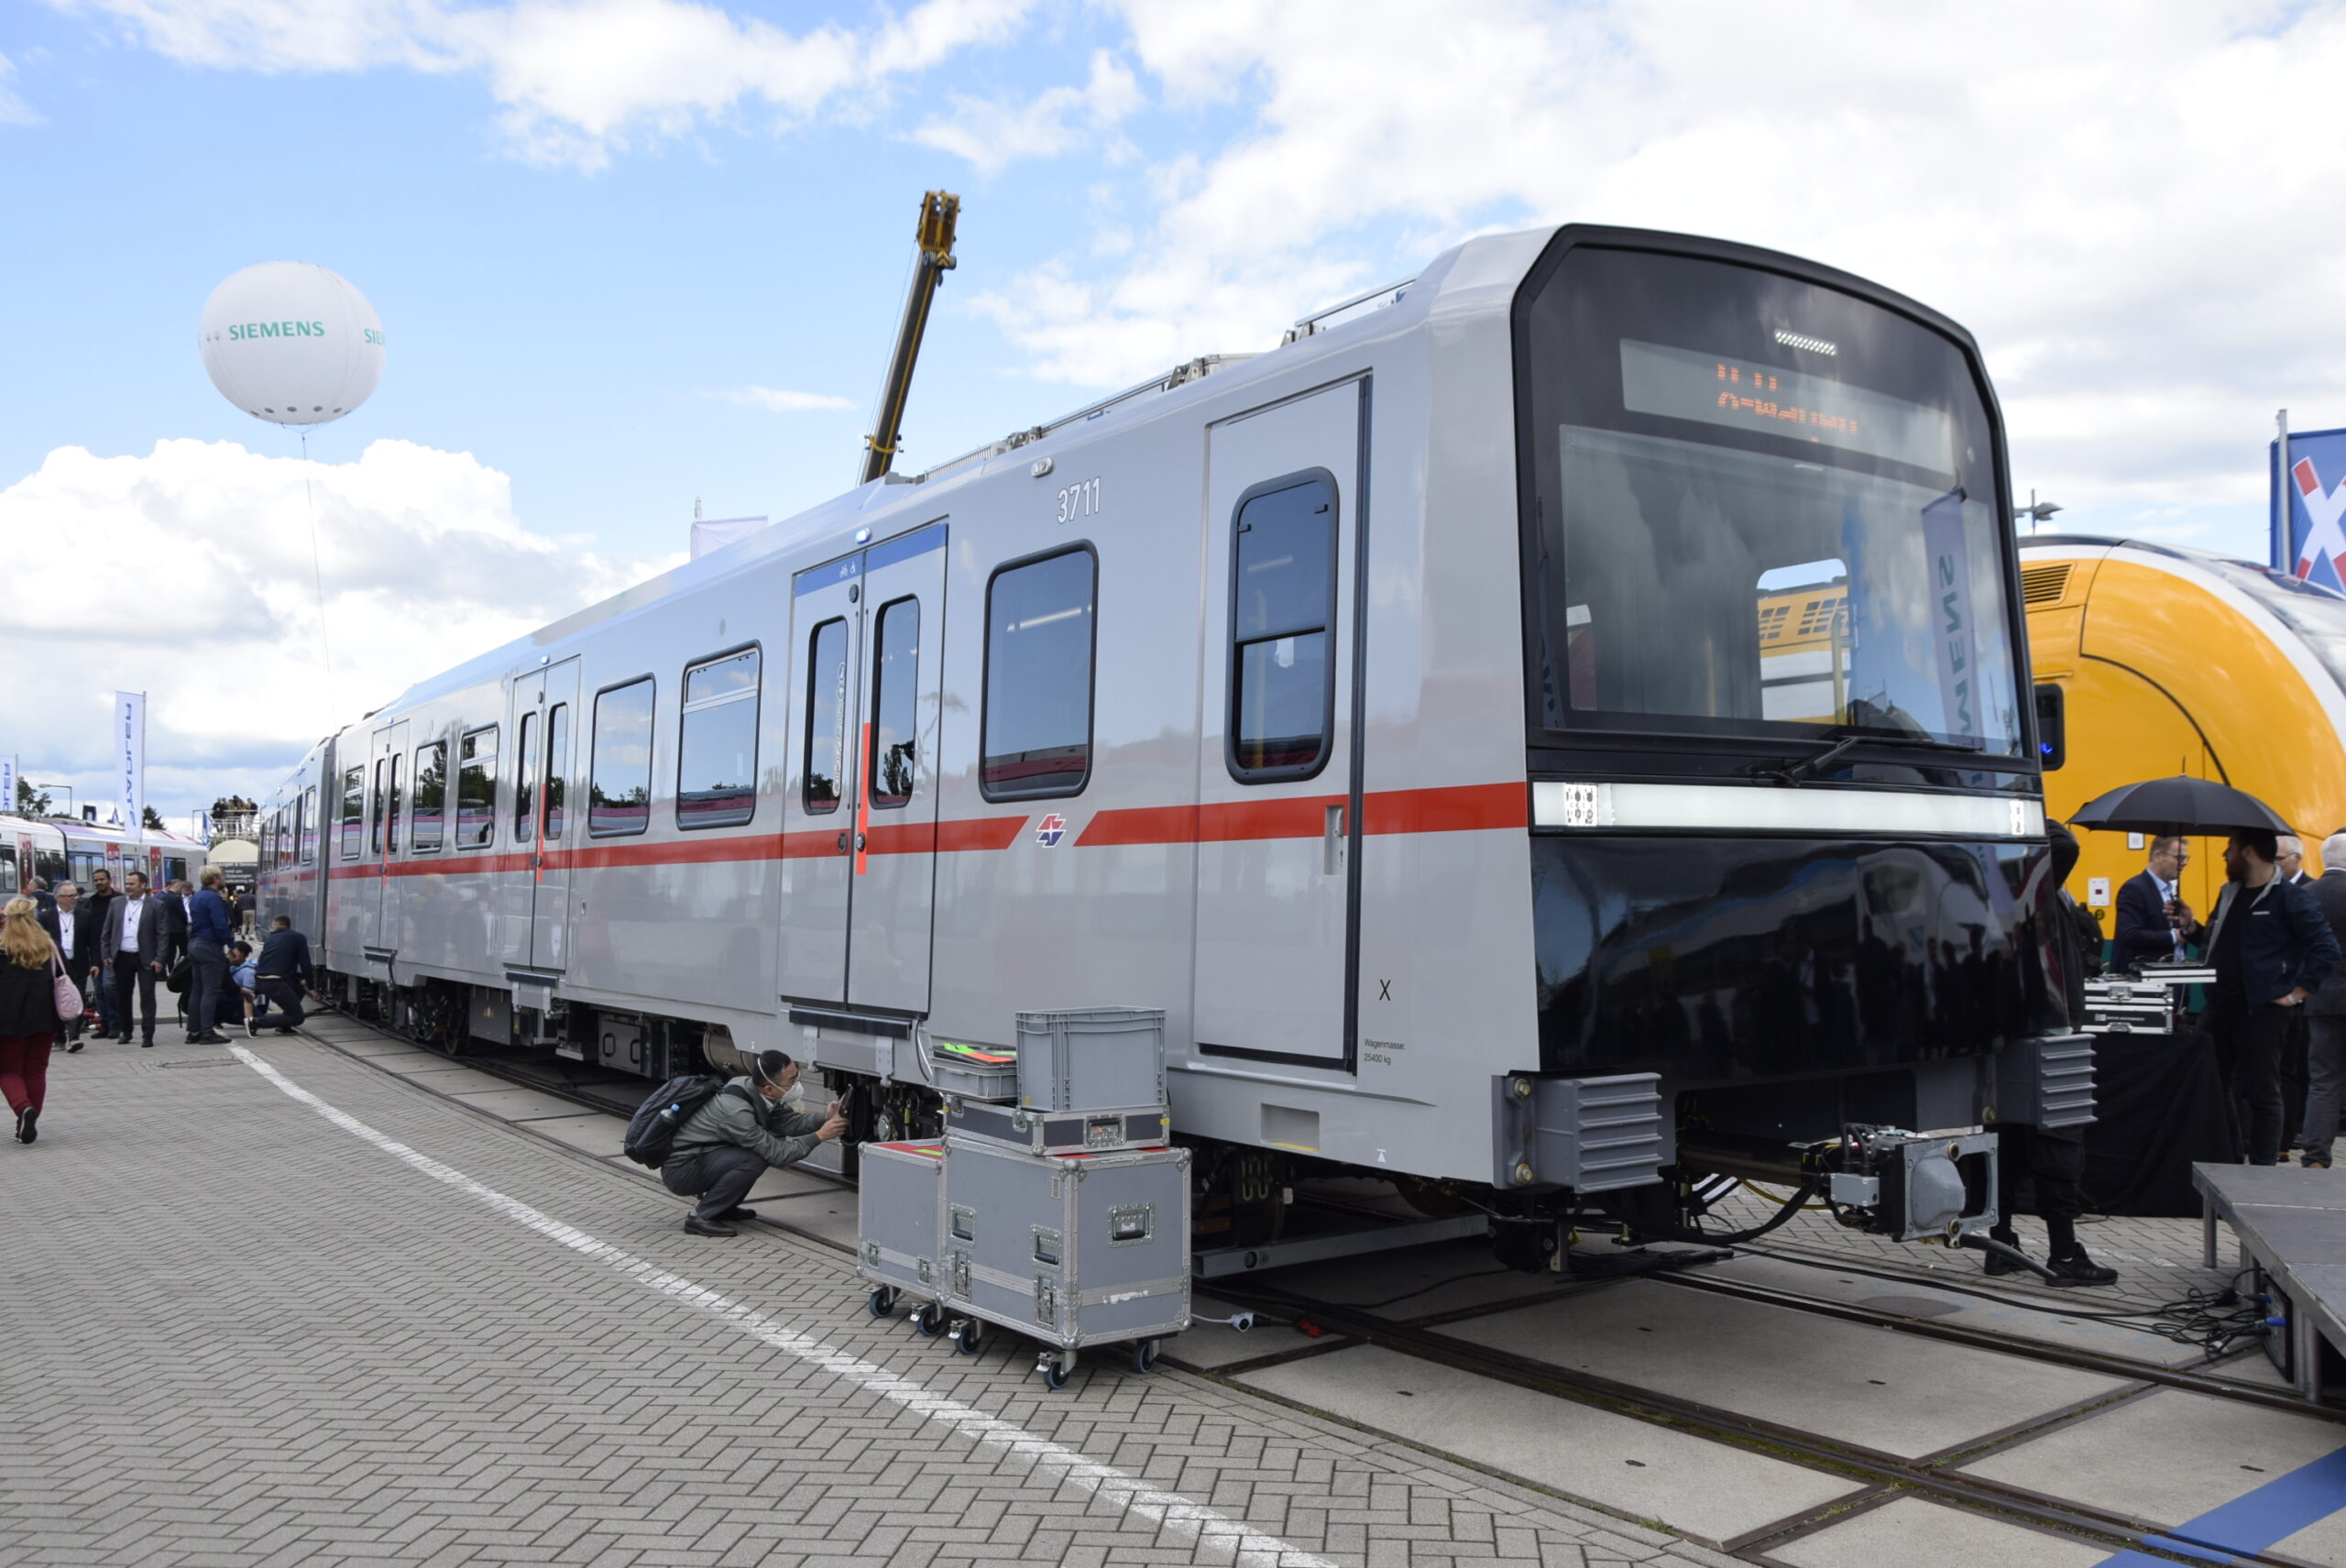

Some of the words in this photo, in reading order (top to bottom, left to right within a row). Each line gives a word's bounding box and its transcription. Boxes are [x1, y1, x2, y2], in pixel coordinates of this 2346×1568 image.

[228, 321, 325, 341] SIEMENS
[1057, 476, 1101, 525] 3711
[1378, 979, 1391, 1001] X
[1364, 1037, 1406, 1050] Wagenmasse:
[1364, 1053, 1382, 1063] 25400
[1384, 1055, 1392, 1066] kg
